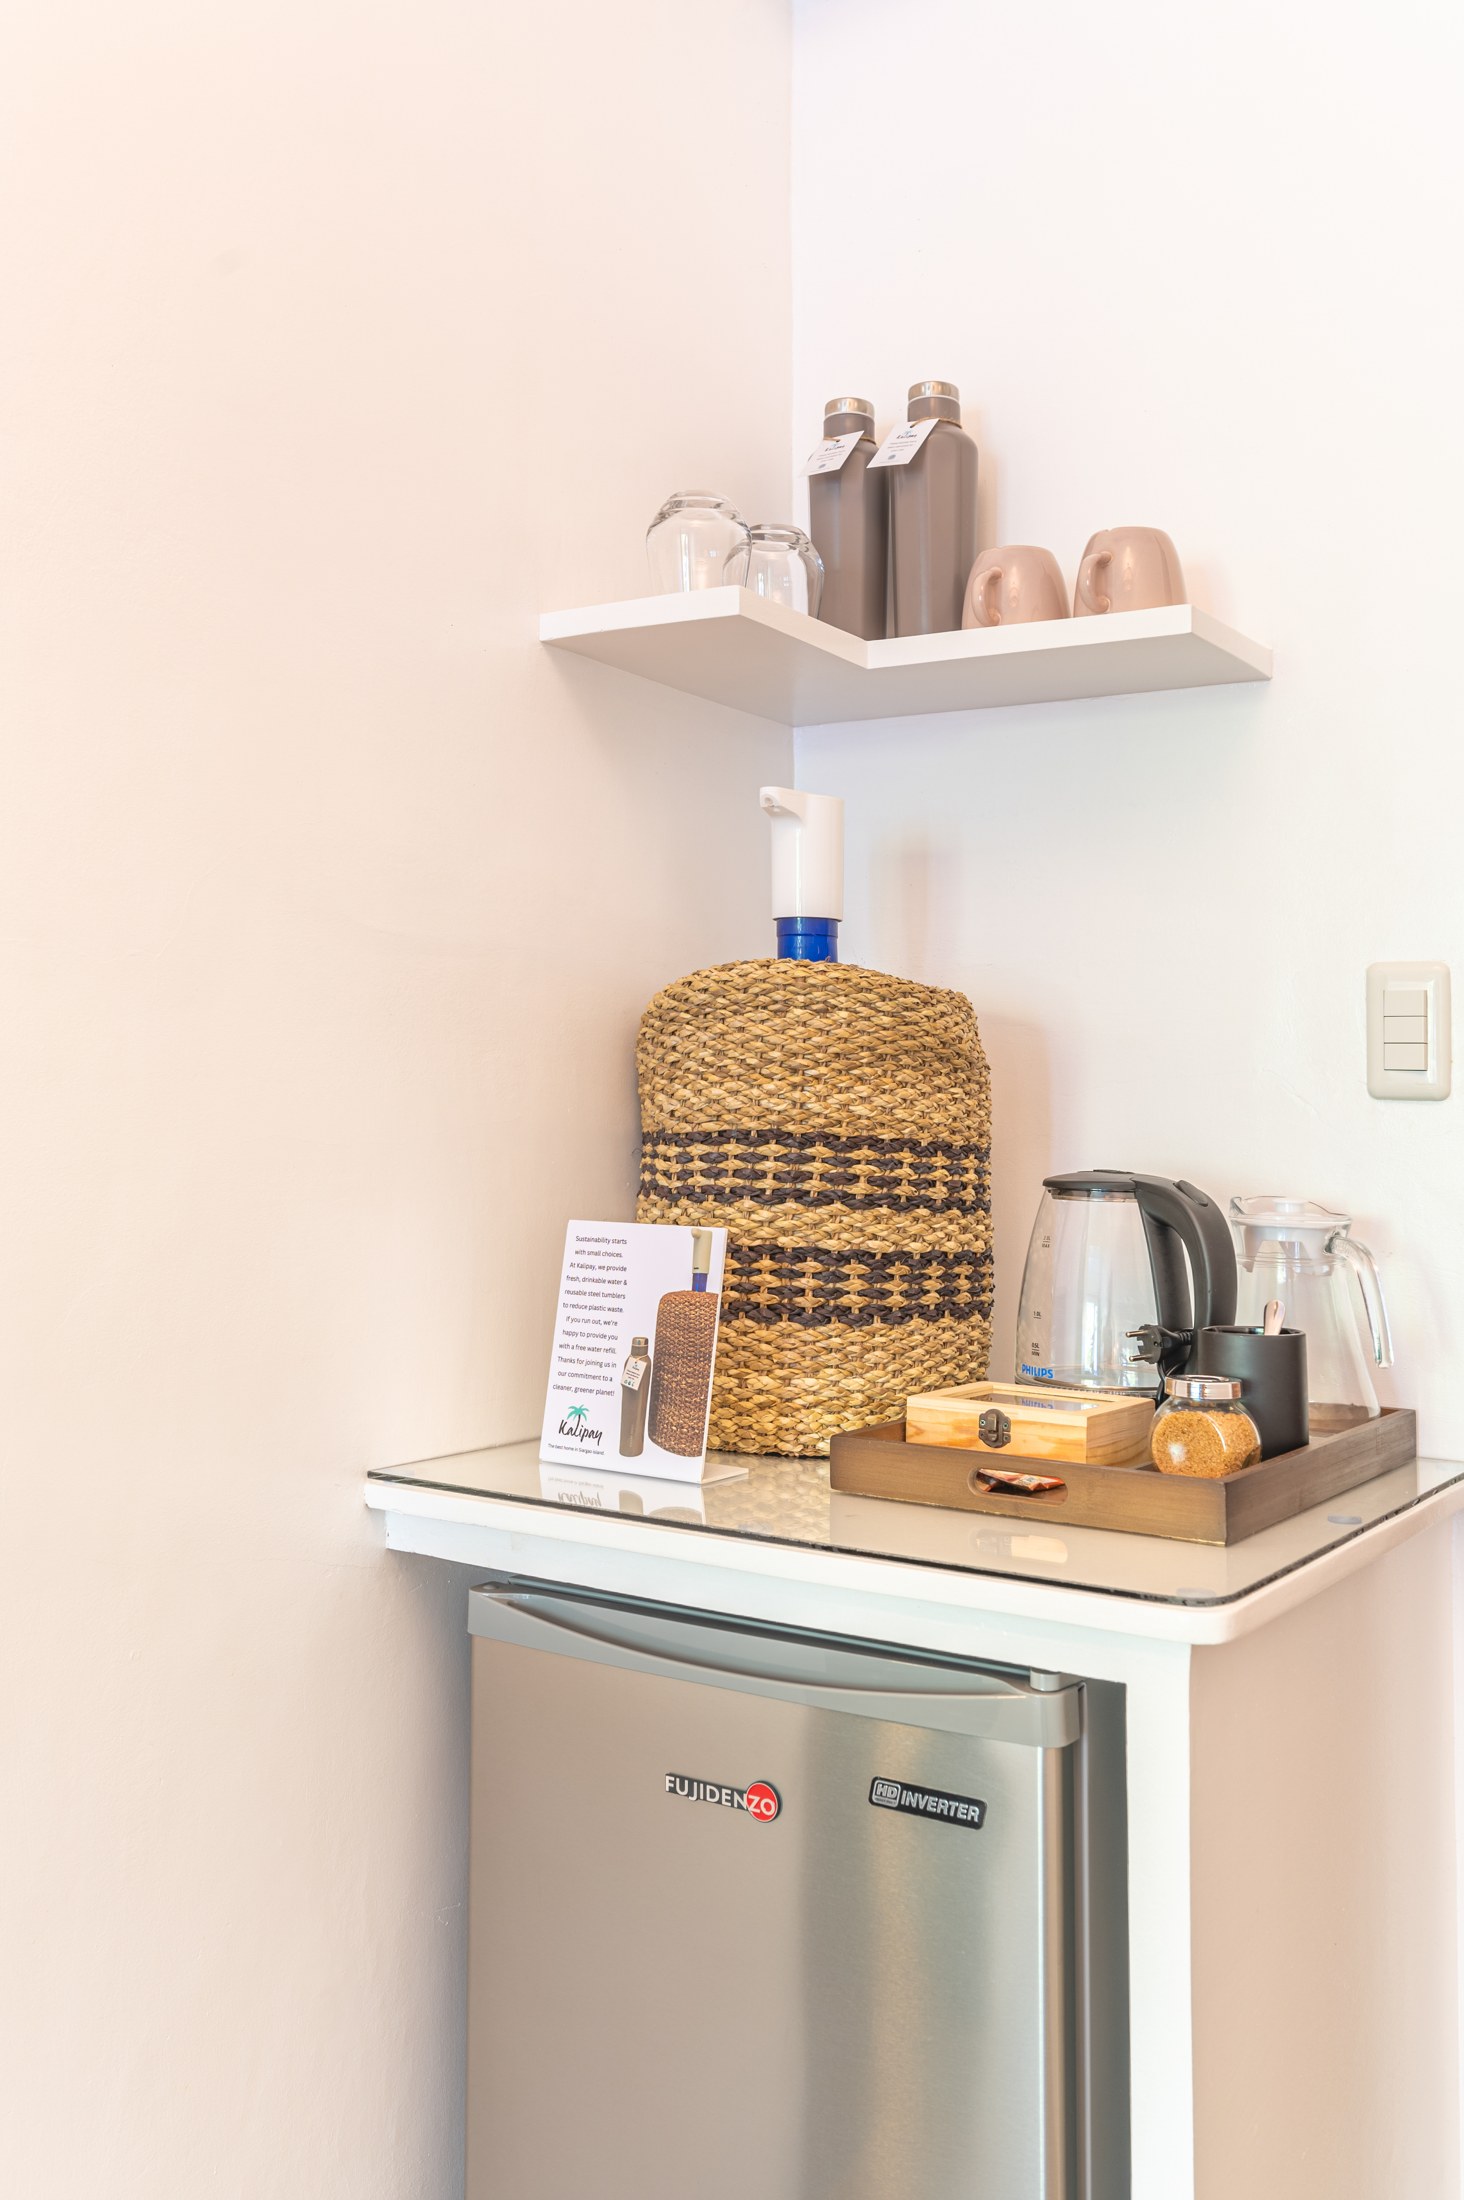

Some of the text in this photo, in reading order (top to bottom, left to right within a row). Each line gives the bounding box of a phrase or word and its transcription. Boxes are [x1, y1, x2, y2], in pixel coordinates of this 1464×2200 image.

[576, 1236, 610, 1245] Sustainability
[577, 1263, 597, 1271] Kalipay,
[566, 1275, 581, 1283] fresh,
[602, 1292, 626, 1300] tumblers
[562, 1329, 579, 1338] happy
[558, 1356, 576, 1364] Thanks
[585, 1360, 603, 1368] joining
[568, 1372, 601, 1381] commitment
[1022, 1364, 1054, 1379] PHILIPS
[553, 1384, 573, 1393] cleaner,
[596, 1389, 615, 1397] planet!
[559, 1414, 603, 1446] Kalipay
[666, 1776, 775, 1816] FUJIDENZO
[876, 1784, 980, 1822] HD INVERTER
